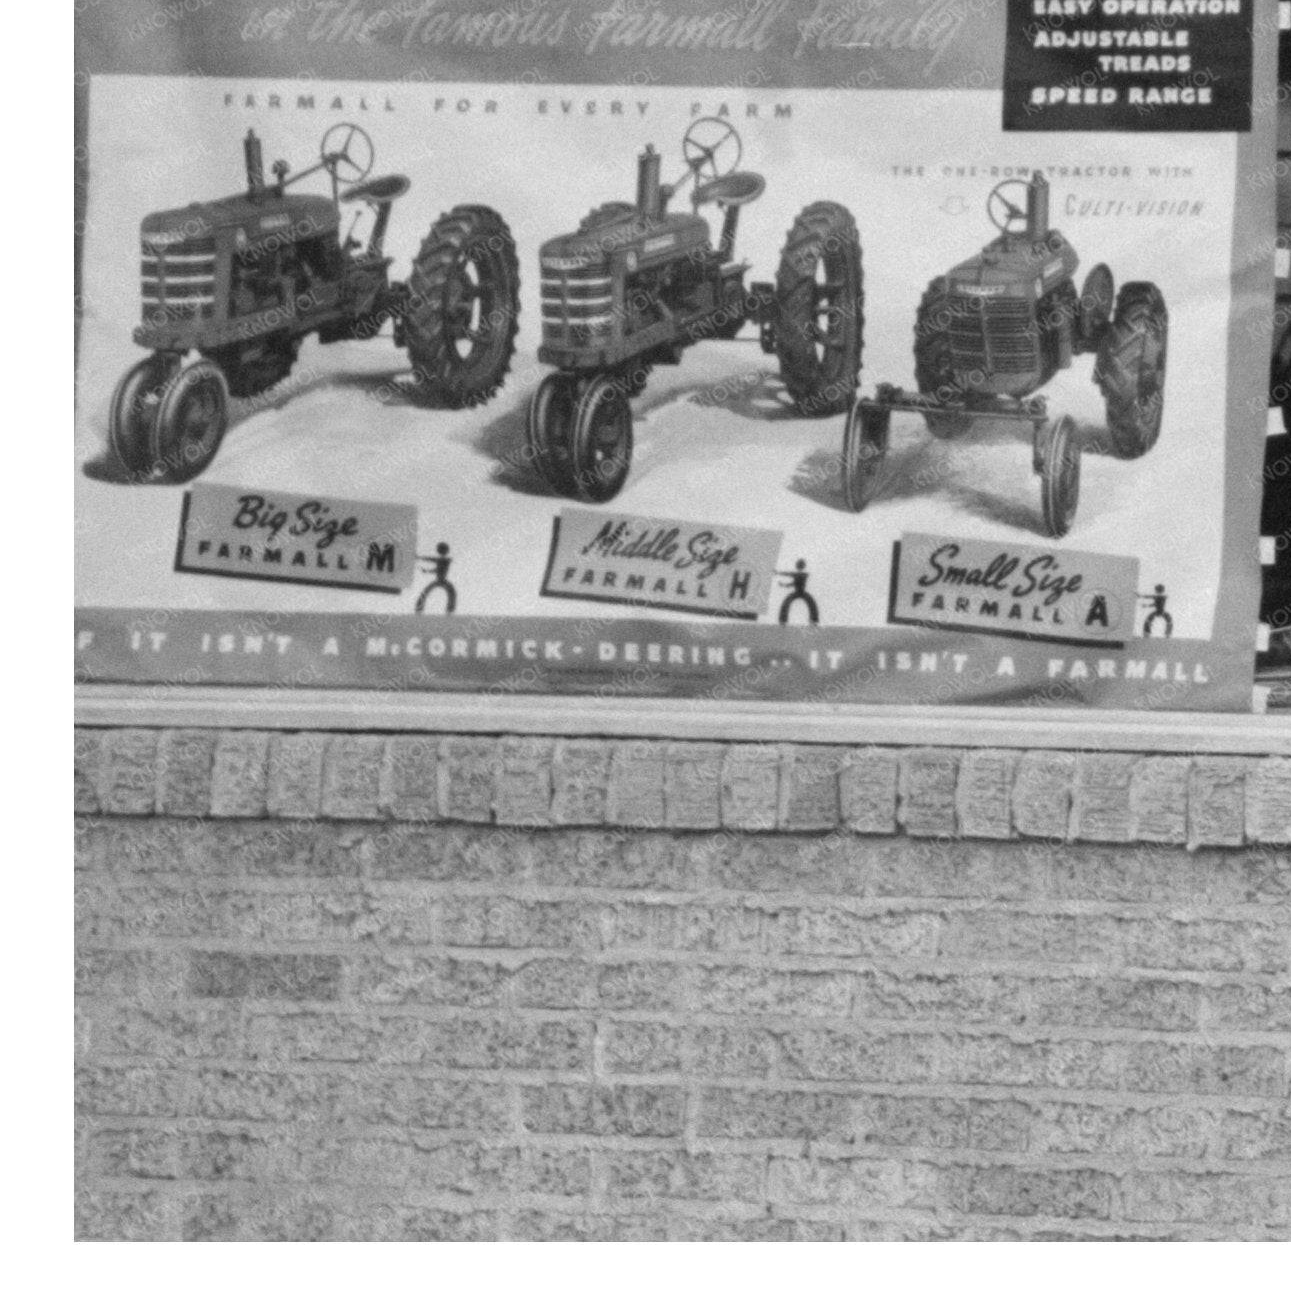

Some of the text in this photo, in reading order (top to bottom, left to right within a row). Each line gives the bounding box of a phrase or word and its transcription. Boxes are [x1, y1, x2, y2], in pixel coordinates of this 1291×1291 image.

[1034, 30, 1190, 49] ADJUSTABLE
[1100, 55, 1192, 73] TREADS
[223, 93, 794, 119] FARMALL FOR EVERY FARM
[1031, 87, 1212, 105] SPEED RANGE
[232, 494, 359, 549] Big Size
[197, 539, 396, 573] FARMALL M
[580, 520, 740, 580] Middle Size
[562, 565, 752, 601] FARMALL H
[917, 543, 1084, 607] Small Size
[911, 592, 1110, 628] FARMALL A
[130, 629, 168, 652] IT
[200, 631, 292, 656] ISN'T
[322, 635, 340, 656] A
[807, 649, 845, 671] IT
[878, 650, 969, 674] ISN'T
[995, 654, 1016, 677] A
[1046, 657, 1210, 685] FARMALL
